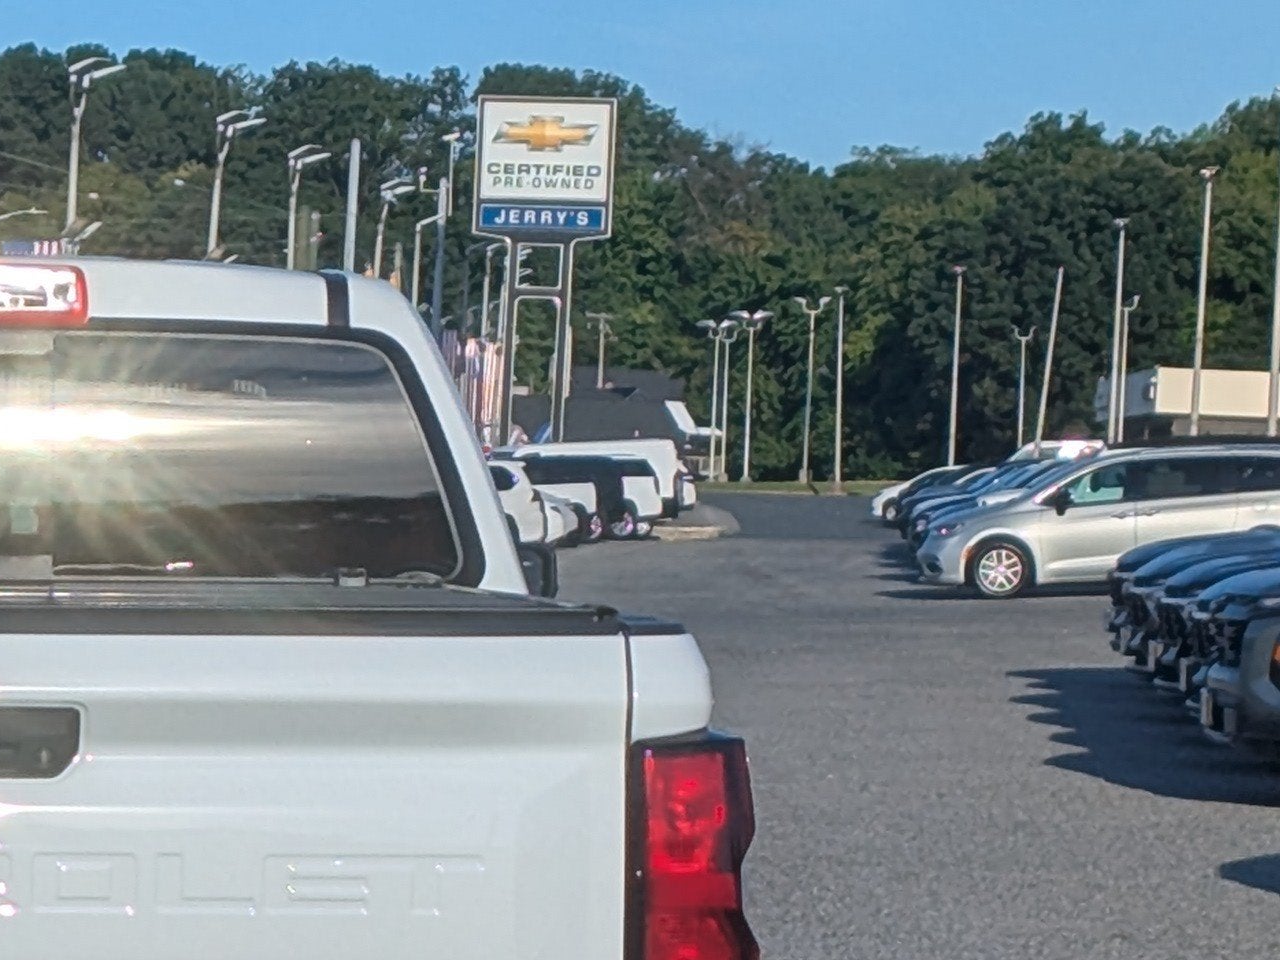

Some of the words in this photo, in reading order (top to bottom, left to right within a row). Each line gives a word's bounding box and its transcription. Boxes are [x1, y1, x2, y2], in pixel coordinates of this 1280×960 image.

[487, 163, 601, 176] CERTIFIED
[493, 177, 594, 189] PRE-OWNED
[494, 209, 589, 225] JERRY'S
